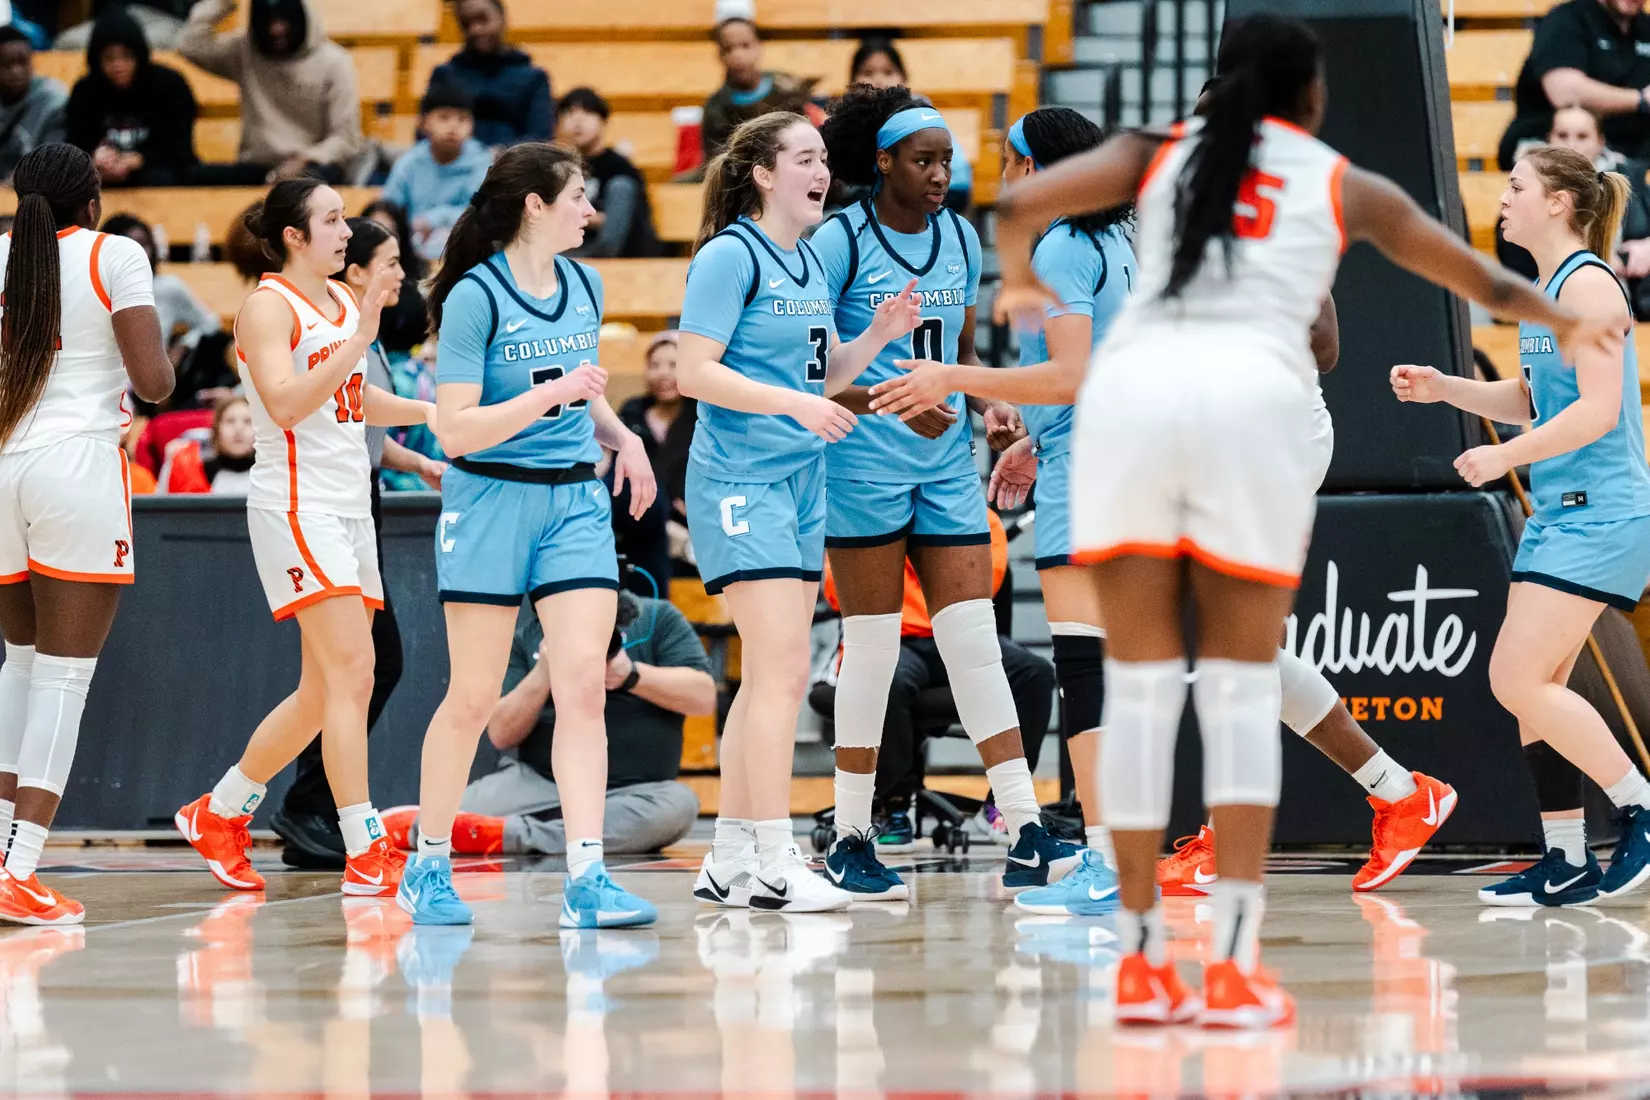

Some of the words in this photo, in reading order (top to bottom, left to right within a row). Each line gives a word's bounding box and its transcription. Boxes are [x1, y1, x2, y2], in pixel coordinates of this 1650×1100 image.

[805, 325, 830, 383] 3
[333, 372, 364, 423] 10
[439, 511, 461, 553] C
[720, 495, 751, 537] C
[114, 539, 130, 568] P
[286, 566, 304, 594] P
[1340, 696, 1444, 722] ETON
